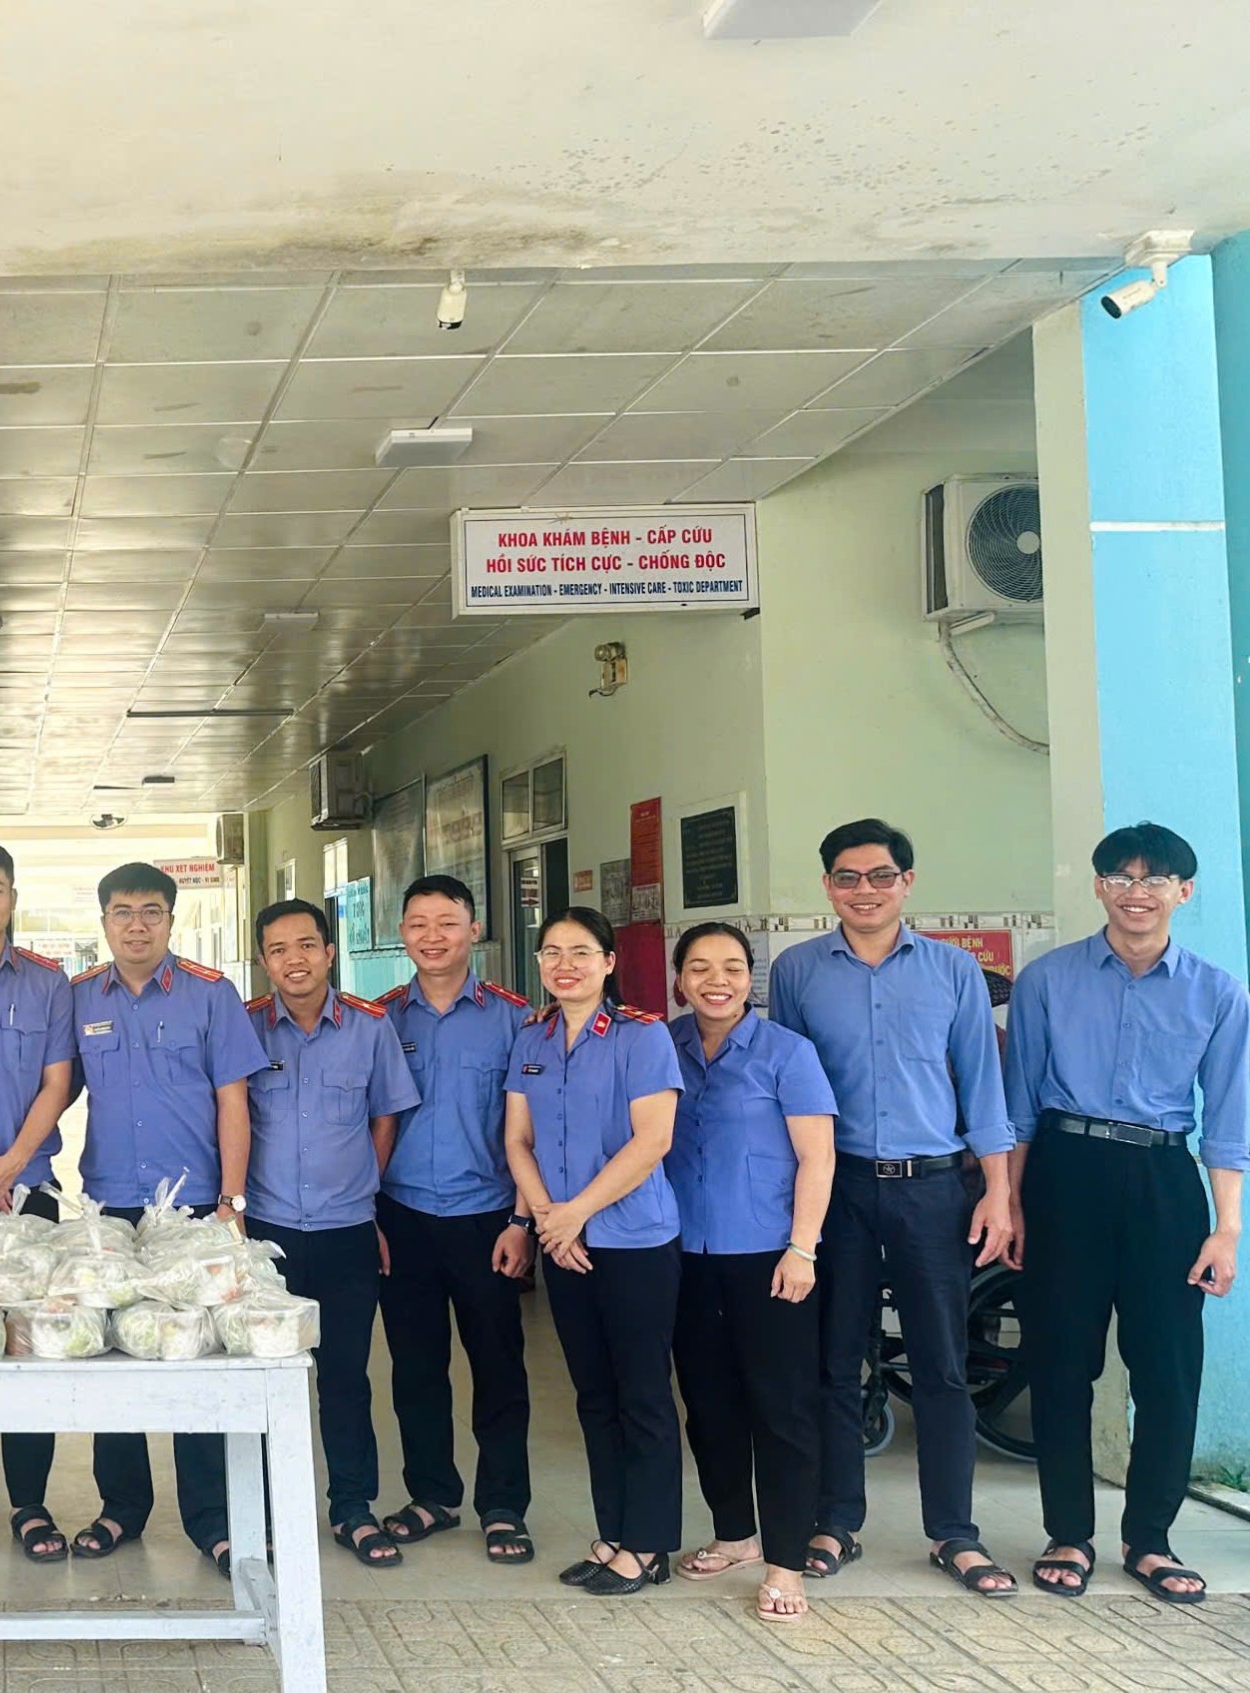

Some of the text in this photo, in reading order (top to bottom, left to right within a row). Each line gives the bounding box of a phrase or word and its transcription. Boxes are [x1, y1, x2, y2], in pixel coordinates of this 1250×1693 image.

[498, 532, 538, 548] KHOA
[543, 527, 586, 547] KHÁM
[591, 527, 630, 549] BỆNH
[647, 524, 677, 544] CẤP
[681, 525, 713, 544] CỨU
[486, 553, 512, 573] HỒI
[517, 554, 547, 573] SỨC
[551, 552, 586, 572] TÍCH
[591, 554, 622, 574] CỰC
[638, 549, 690, 570] CHỐNG
[695, 550, 726, 572] ĐỘC
[471, 585, 503, 598] MEDICAL
[504, 584, 552, 597] EXAMINATION
[559, 583, 603, 596] EMERGENCY
[609, 582, 646, 595] INTENSIVE
[647, 581, 667, 594] CARE
[673, 581, 694, 594] TOXIC
[696, 580, 743, 593] DEPARTMENT
